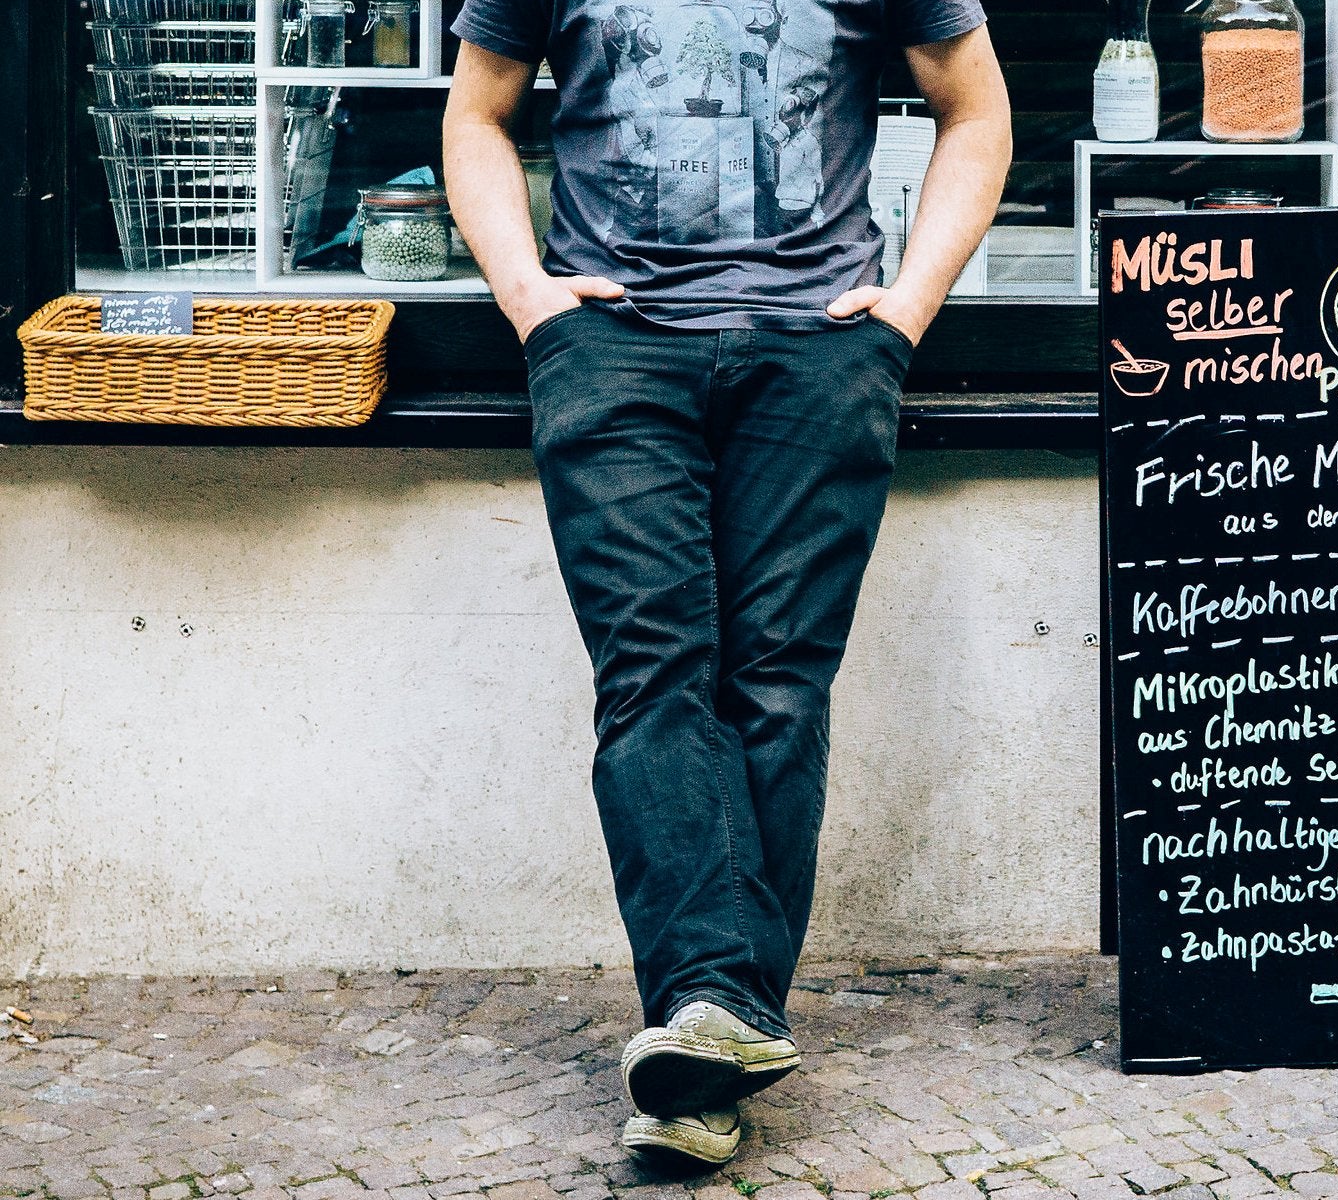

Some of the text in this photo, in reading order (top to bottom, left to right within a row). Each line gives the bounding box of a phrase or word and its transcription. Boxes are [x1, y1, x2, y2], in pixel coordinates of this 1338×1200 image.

[670, 160, 708, 173] TREE
[728, 158, 748, 173] TREE
[1163, 285, 1295, 333] selber
[1184, 337, 1322, 390] mischen
[1132, 438, 1295, 508] Frische
[1222, 512, 1280, 536] aus
[1136, 728, 1188, 755] aus
[1203, 707, 1337, 751] Chemnitz
[1169, 758, 1291, 793] duftende
